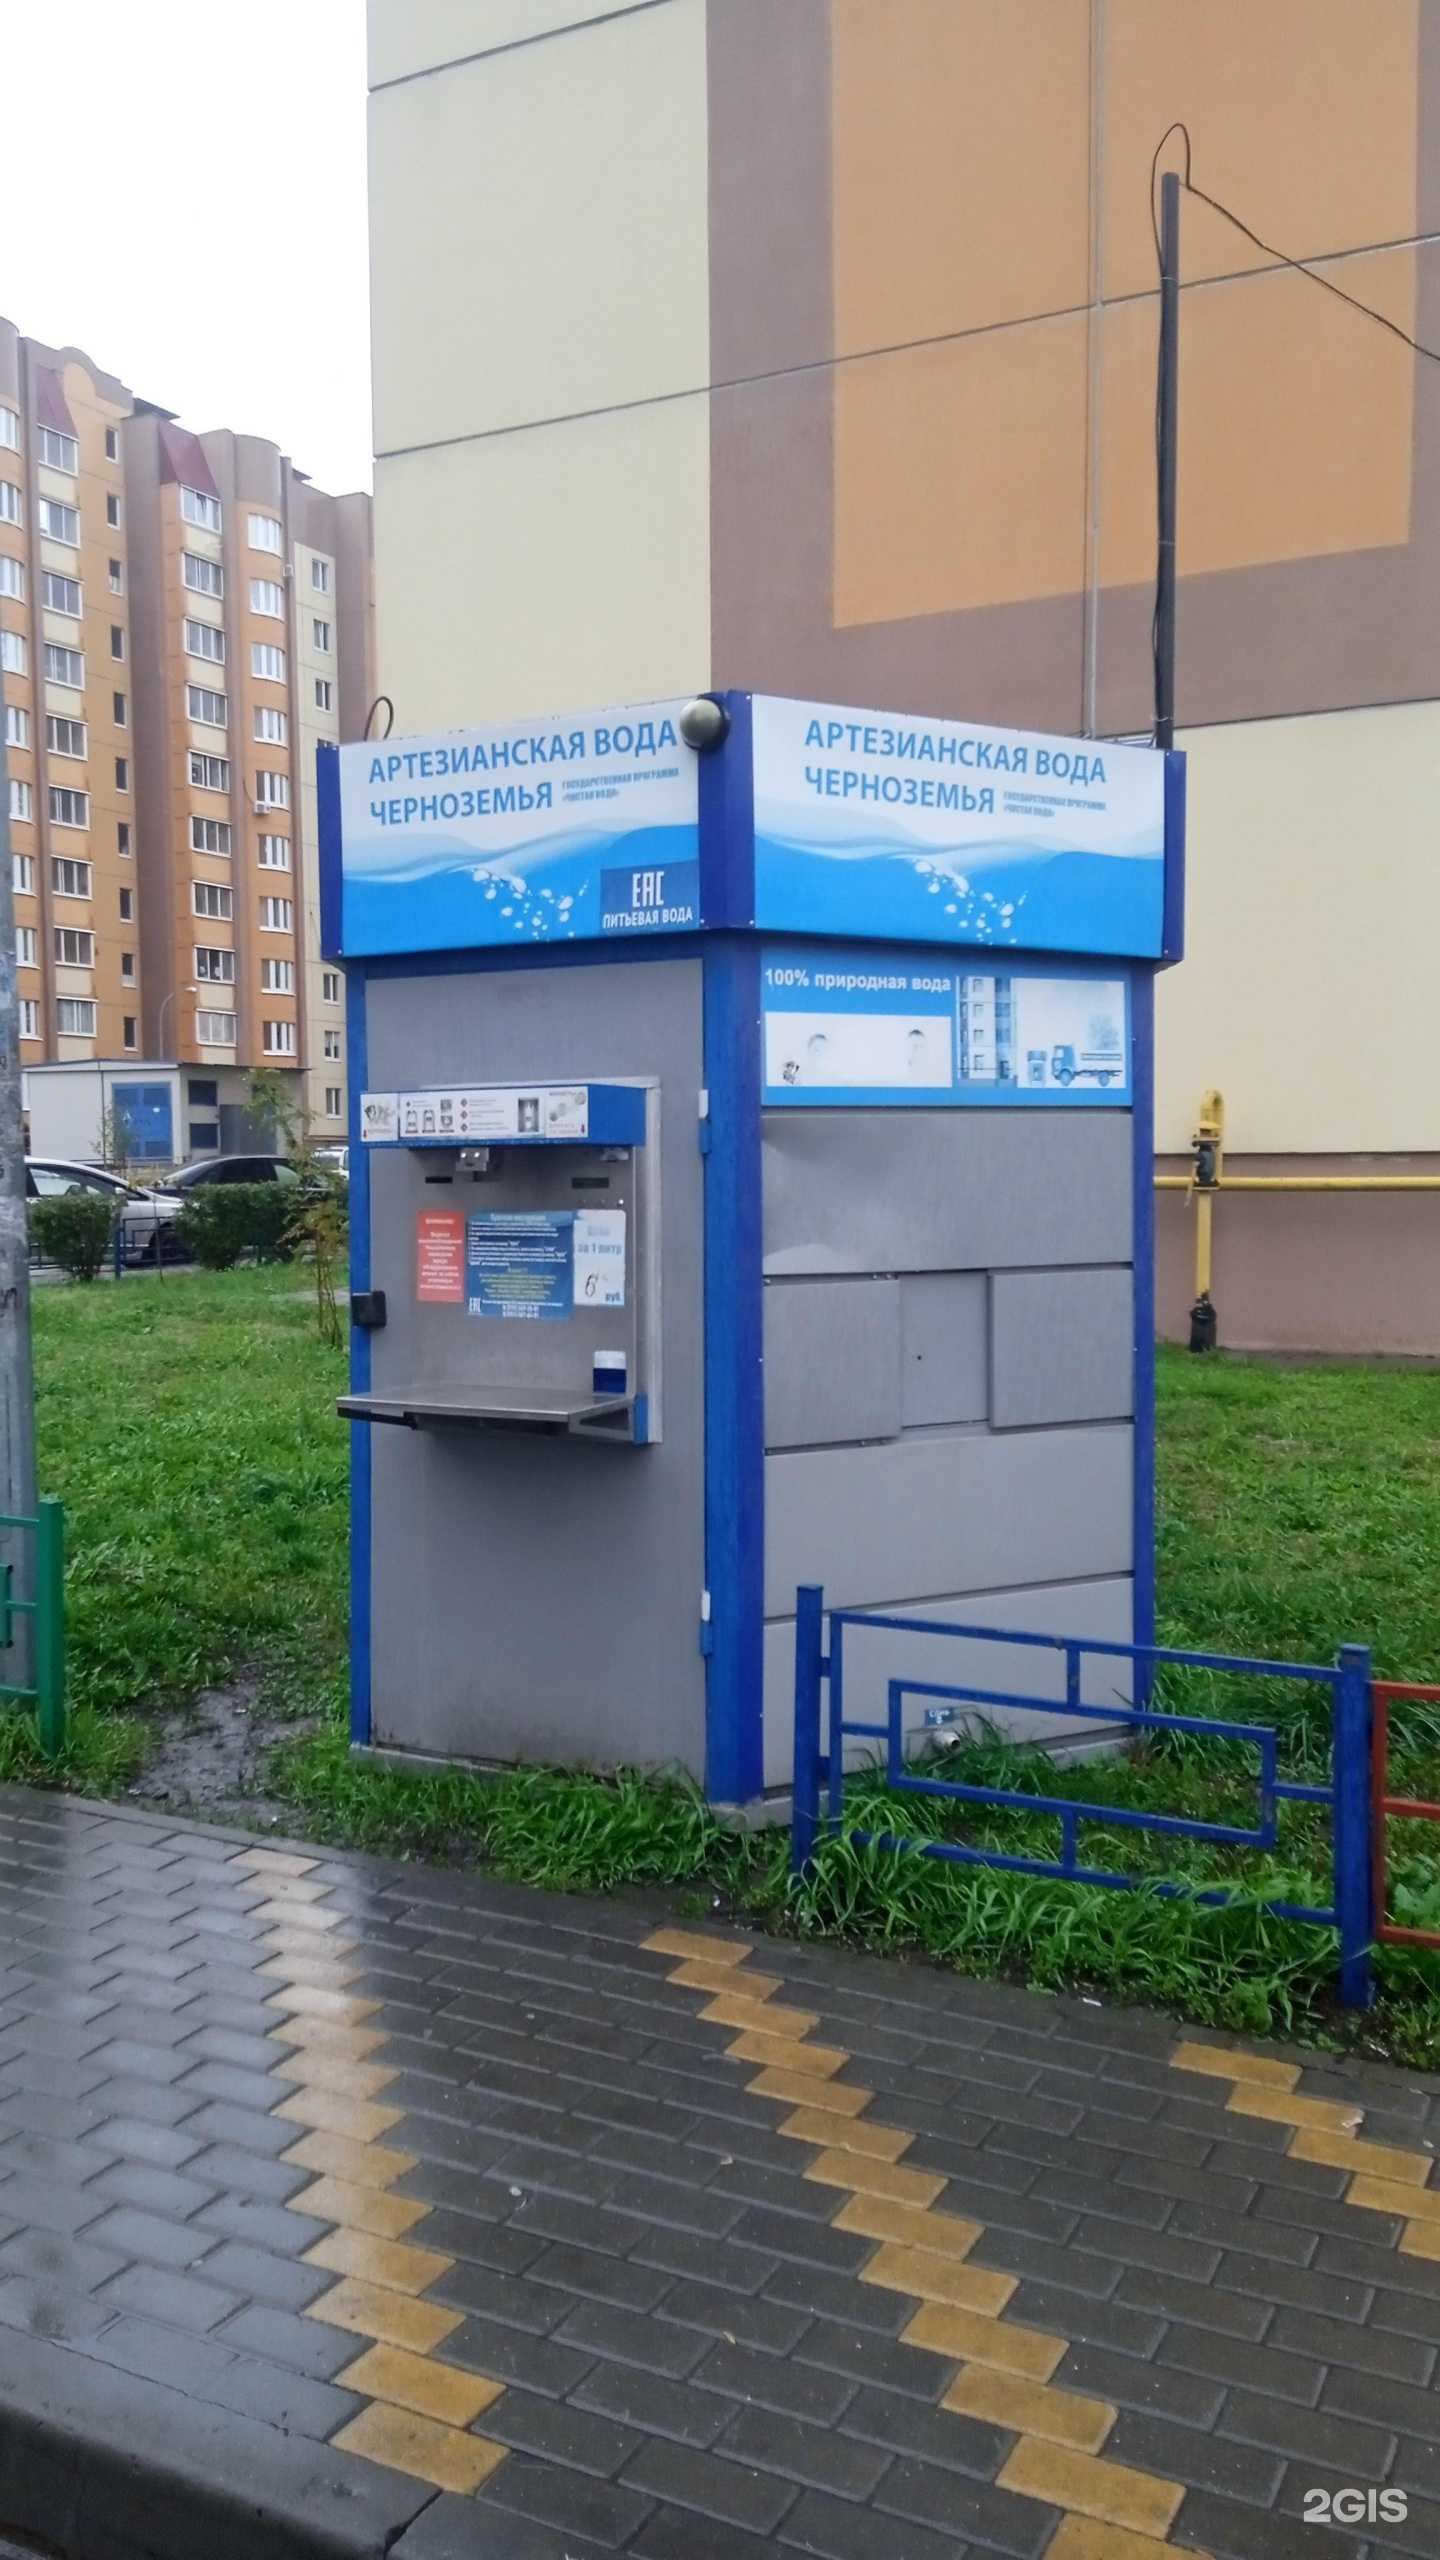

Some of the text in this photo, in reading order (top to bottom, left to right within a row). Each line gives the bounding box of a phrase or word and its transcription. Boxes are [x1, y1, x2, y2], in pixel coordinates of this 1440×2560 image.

[369, 720, 678, 783] АРТЕЗИАНСКАЯ ВОДА
[804, 719, 1107, 786] АРТЕЗИАНСКАЯ ВОДА
[370, 782, 552, 825] ЧЕРНОЗЕМЬЯ
[804, 766, 995, 814] ЧЕРНОЗЕМЬЯ
[603, 906, 693, 929] ПИТЬЕВАЯ ВОДА
[765, 969, 951, 992] 100% природная вода
